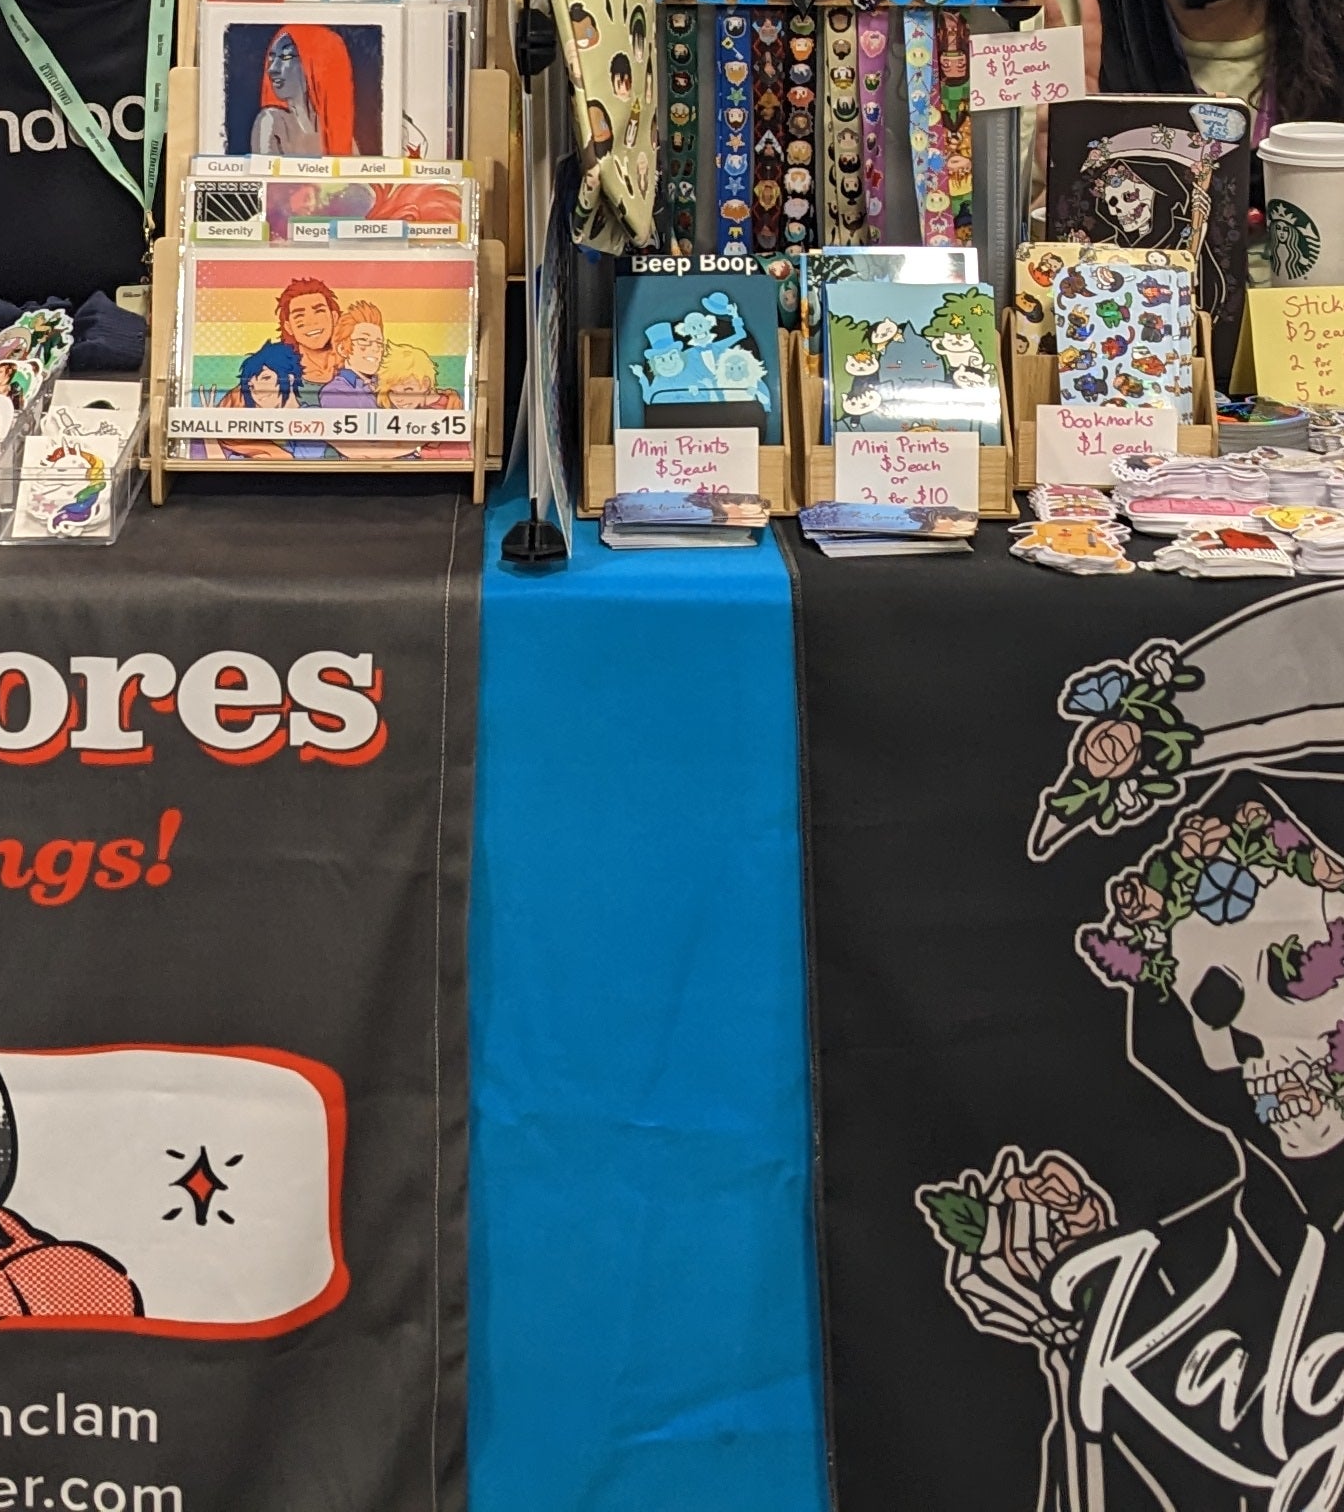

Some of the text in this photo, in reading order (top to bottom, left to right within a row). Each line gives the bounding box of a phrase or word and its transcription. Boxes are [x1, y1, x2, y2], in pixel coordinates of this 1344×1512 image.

[971, 37, 1047, 62] Lanyards
[987, 59, 1050, 77] $12 each
[973, 83, 1069, 107] 3 for $30
[298, 163, 451, 175] Violet Ariel Ursula
[208, 226, 254, 237] Serenity
[631, 253, 758, 276] Beep Boop
[1286, 321, 1316, 342] $3
[1290, 356, 1302, 372] 2
[1313, 356, 1333, 368] for
[1297, 383, 1310, 402] 5
[1318, 385, 1336, 398] for
[170, 414, 467, 435] SMALL PRINTS (5x7) $5 4 for $15
[1057, 408, 1154, 428] Bookmarks
[676, 436, 730, 455] Prints
[851, 436, 949, 456] Mini Prints
[1077, 432, 1153, 455] $1 each
[655, 458, 717, 478] $5 each
[880, 454, 940, 472] $5 each
[891, 476, 909, 484] or
[888, 485, 948, 504] for $10
